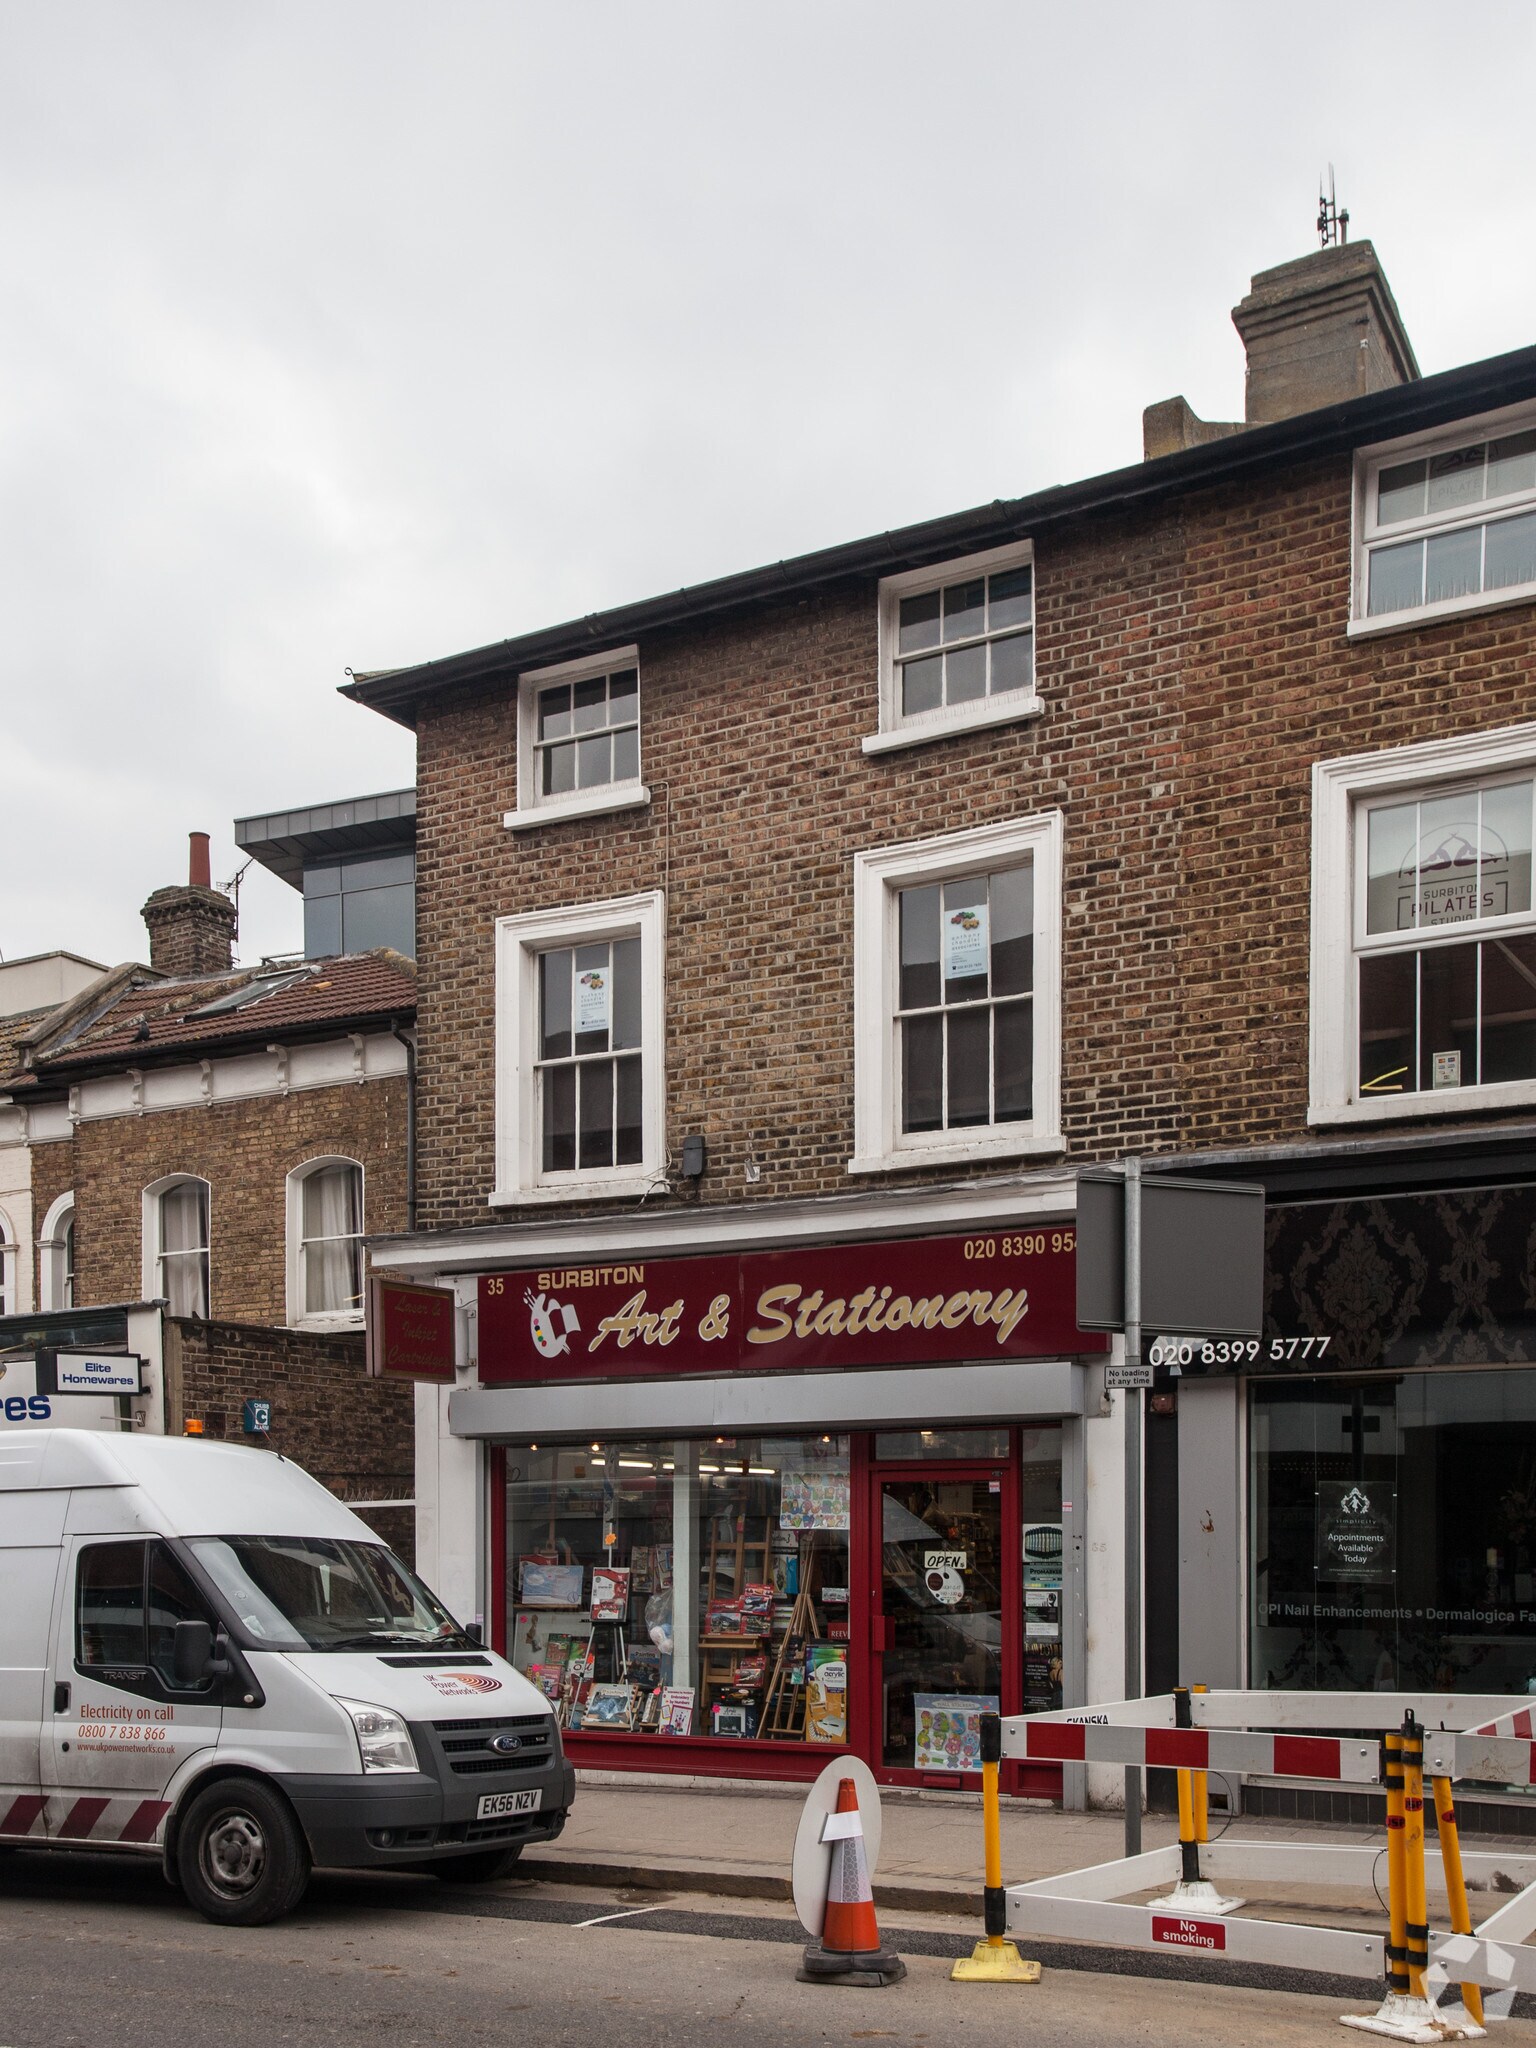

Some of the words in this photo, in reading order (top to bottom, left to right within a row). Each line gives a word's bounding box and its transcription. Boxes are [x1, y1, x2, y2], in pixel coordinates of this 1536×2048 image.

[1412, 892, 1494, 917] PILATES
[964, 1239, 996, 1260] 020
[1001, 1235, 1045, 1257] 8390
[1051, 1232, 1077, 1253] 95
[537, 1266, 644, 1290] SURBITON
[487, 1278, 504, 1296] 35
[588, 1289, 684, 1352] Art
[698, 1294, 731, 1342] &
[746, 1284, 1029, 1345] Stationery
[1149, 1343, 1193, 1366] 020
[1201, 1340, 1260, 1364] 8399
[1269, 1336, 1331, 1361] 5777
[85, 1363, 111, 1372] Elite
[1121, 1369, 1149, 1378] loading
[62, 1374, 134, 1385] Homewares
[1133, 1377, 1150, 1385] time
[0, 1395, 51, 1421] es
[1328, 1533, 1384, 1542] Appointments
[1338, 1544, 1374, 1553] Available
[927, 1556, 961, 1568] OPEN
[1343, 1554, 1367, 1564] Today
[1258, 1603, 1281, 1615] OPI
[1284, 1604, 1309, 1616] Nail
[1313, 1604, 1412, 1619] Enhancements
[1426, 1607, 1515, 1624] Dermalogica
[103, 1671, 148, 1680] TRANSIT
[423, 1674, 438, 1682] UK
[431, 1681, 458, 1689] Power
[438, 1688, 478, 1697] Networks
[80, 1704, 133, 1721] Electricity
[136, 1709, 150, 1719] on
[154, 1706, 174, 1720] call
[78, 1725, 106, 1738] 0800
[109, 1726, 117, 1738] 7
[119, 1726, 141, 1739] 838
[144, 1727, 166, 1740] 866
[77, 1742, 175, 1754] www.ukpowernetworks.co.uk
[502, 1738, 518, 1749] Ford
[483, 1794, 513, 1815] EK56
[515, 1791, 538, 1809] NZV
[1180, 1920, 1197, 1932] No
[1163, 1931, 1214, 1948] smoking
